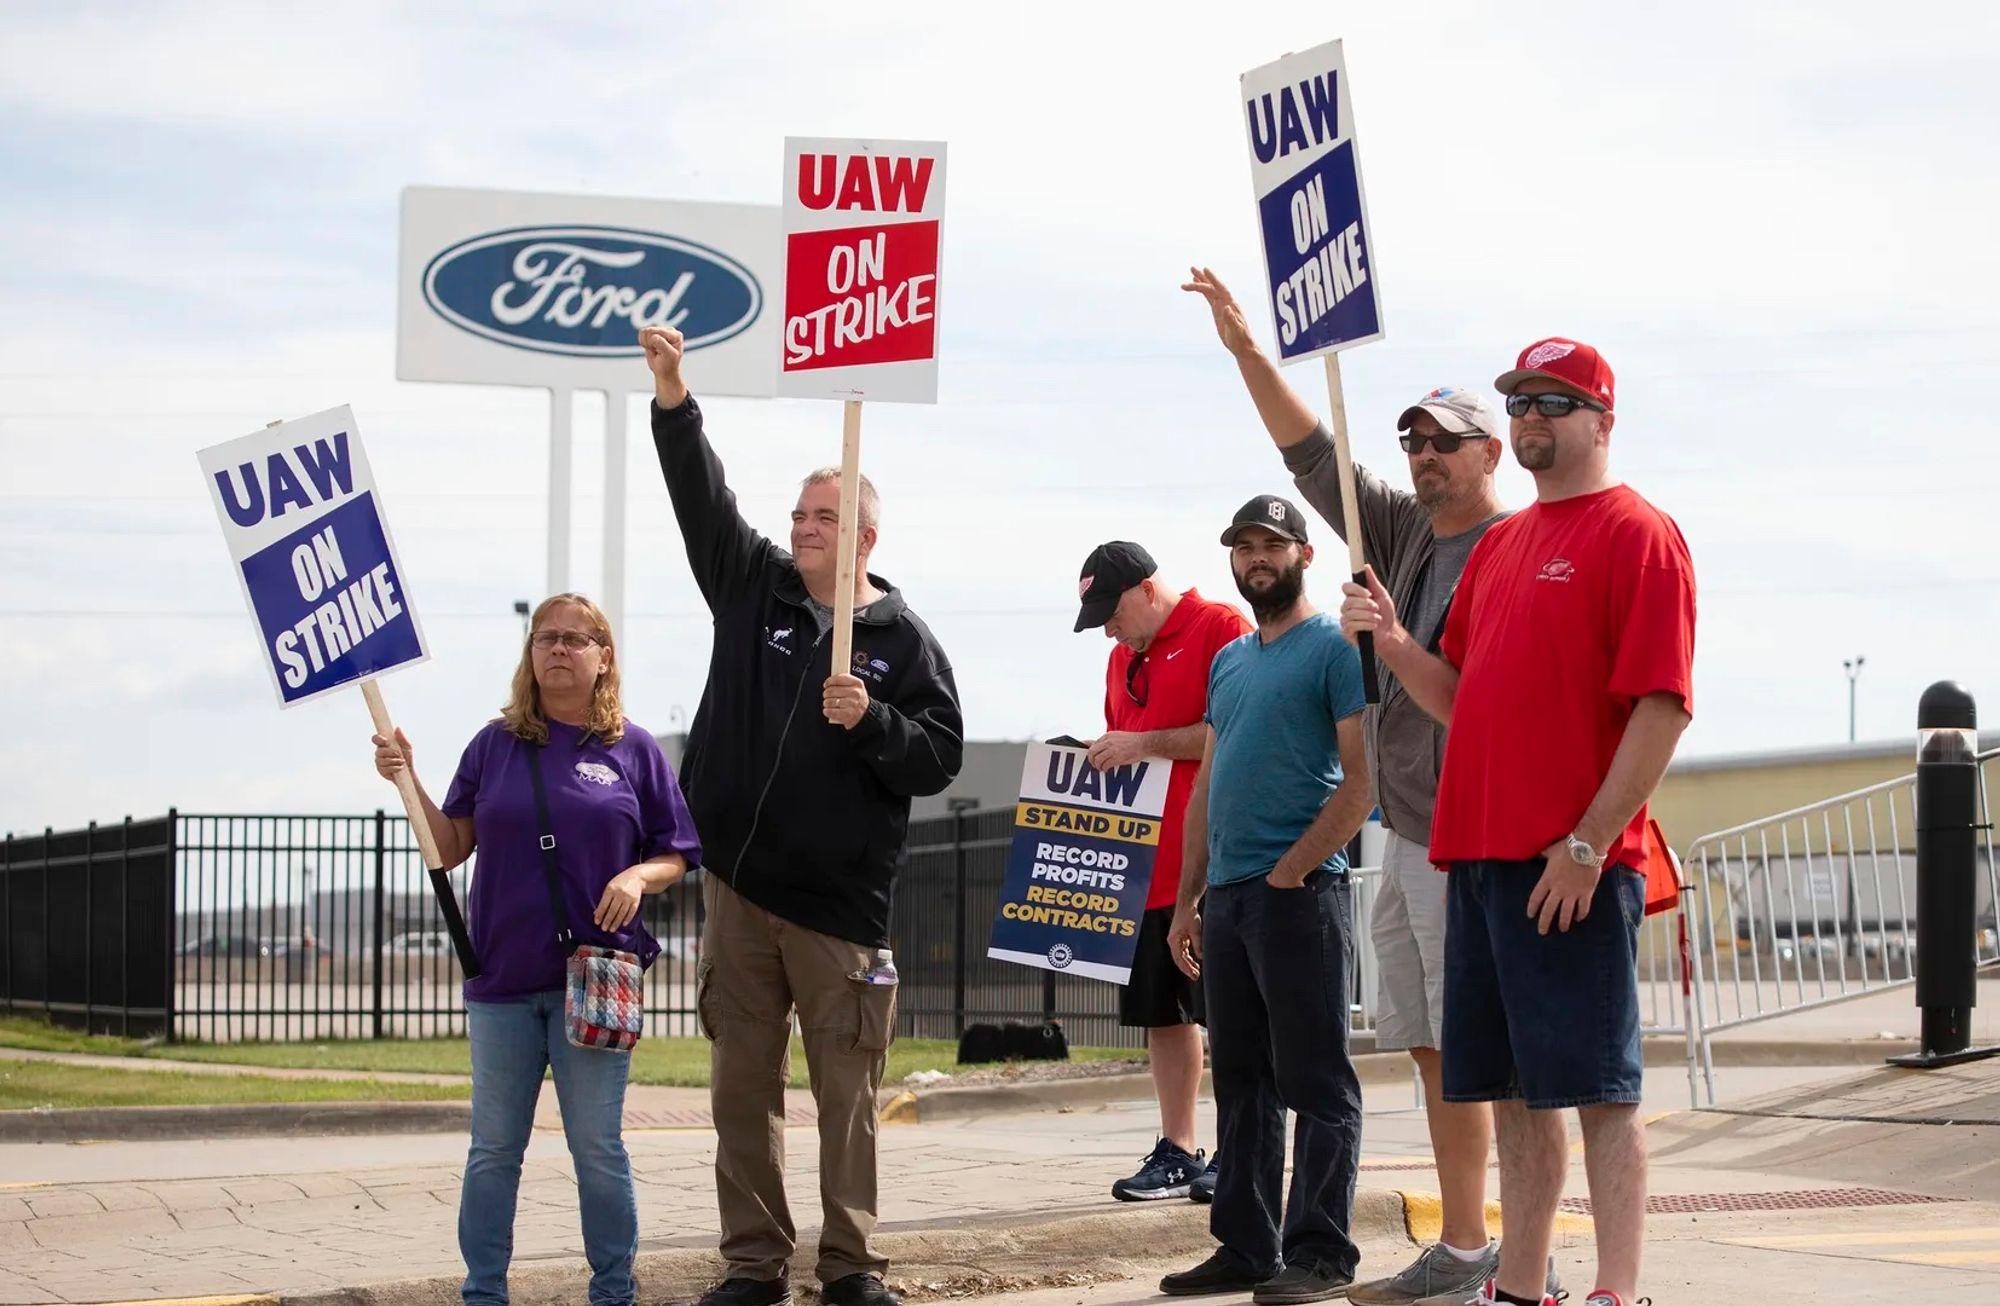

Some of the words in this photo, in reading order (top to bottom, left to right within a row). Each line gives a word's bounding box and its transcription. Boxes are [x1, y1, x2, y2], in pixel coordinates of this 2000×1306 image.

[1247, 69, 1338, 164] UAW
[798, 153, 934, 213] UAW
[1290, 172, 1329, 255] ON
[491, 242, 695, 328] Ford
[827, 232, 886, 294] ON
[1276, 220, 1367, 346] STRIKE
[785, 273, 935, 365] STRIKE
[214, 431, 353, 527] UAW
[291, 525, 348, 602] ON
[275, 562, 402, 689] STRIKE
[1046, 750, 1149, 808] UAW
[1024, 806, 1110, 835] STAND
[1118, 820, 1152, 840] UP
[1036, 842, 1129, 871] RECORD
[1026, 885, 1120, 914] RECORD
[1031, 863, 1126, 892] PROFITS
[1002, 902, 1136, 937] CONTRACTS
